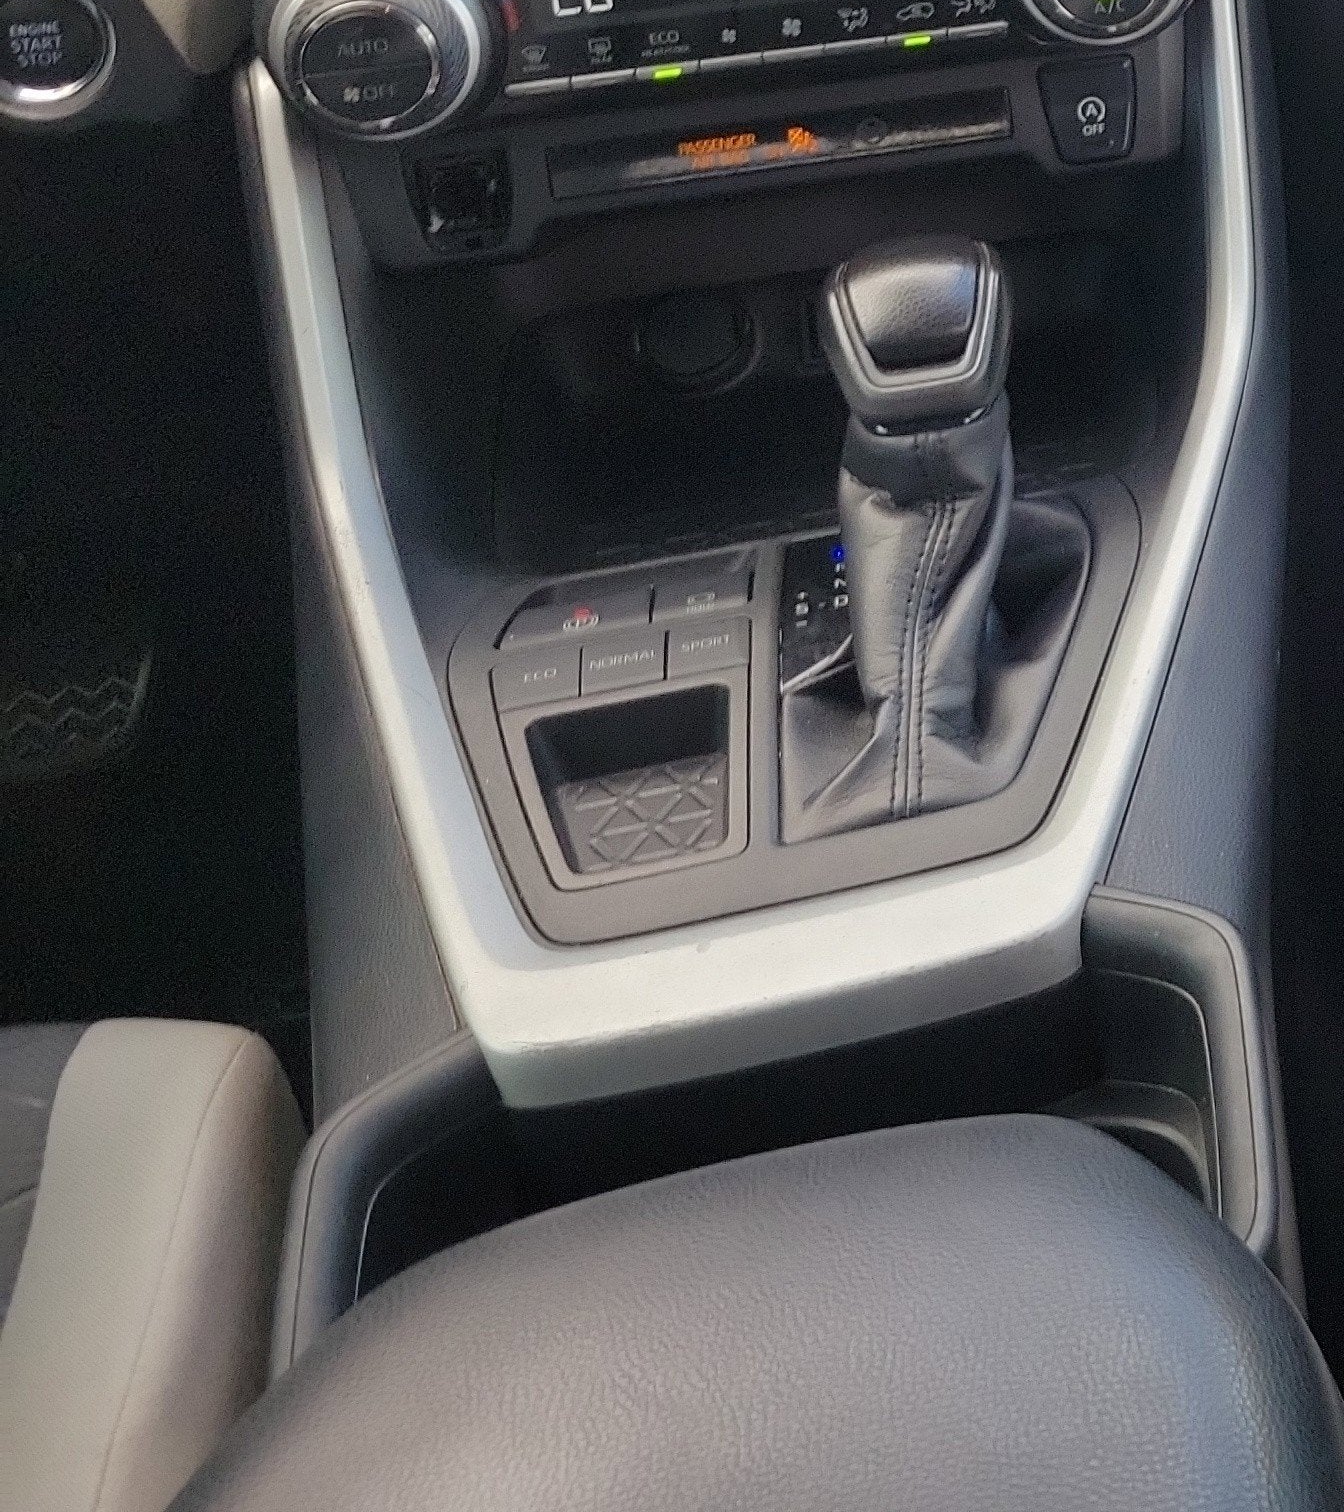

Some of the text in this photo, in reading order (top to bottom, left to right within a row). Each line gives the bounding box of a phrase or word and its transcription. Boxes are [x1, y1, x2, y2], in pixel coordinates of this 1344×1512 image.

[9, 20, 61, 38] ENGINE
[10, 35, 62, 54] START
[337, 38, 389, 57] AUTO
[17, 51, 63, 68] STOP
[362, 84, 396, 102] OFF
[1082, 122, 1106, 138] OFF
[681, 634, 731, 652] SPORT
[589, 648, 656, 670] NORMAL
